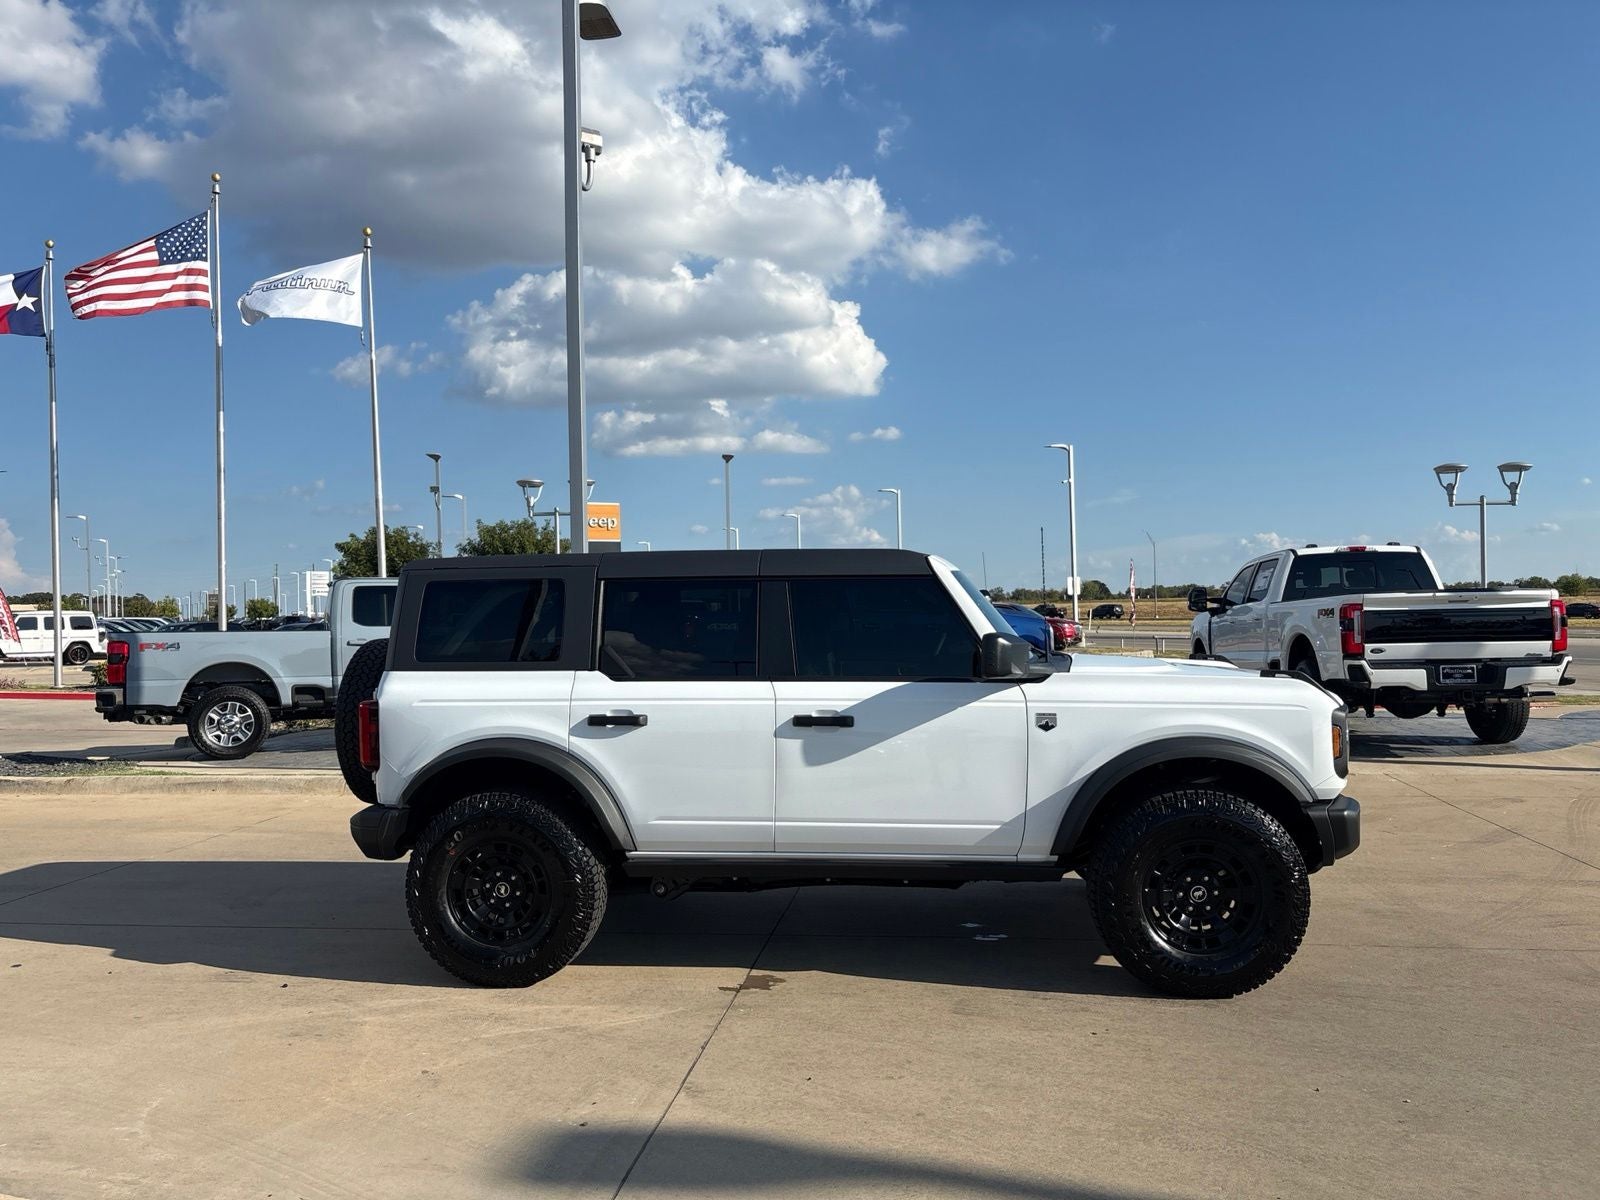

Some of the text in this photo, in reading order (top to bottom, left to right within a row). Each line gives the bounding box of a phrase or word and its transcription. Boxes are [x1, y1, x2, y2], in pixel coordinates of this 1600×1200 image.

[246, 275, 355, 296] atinum
[587, 517, 618, 532] eep
[138, 642, 181, 652] FX4
